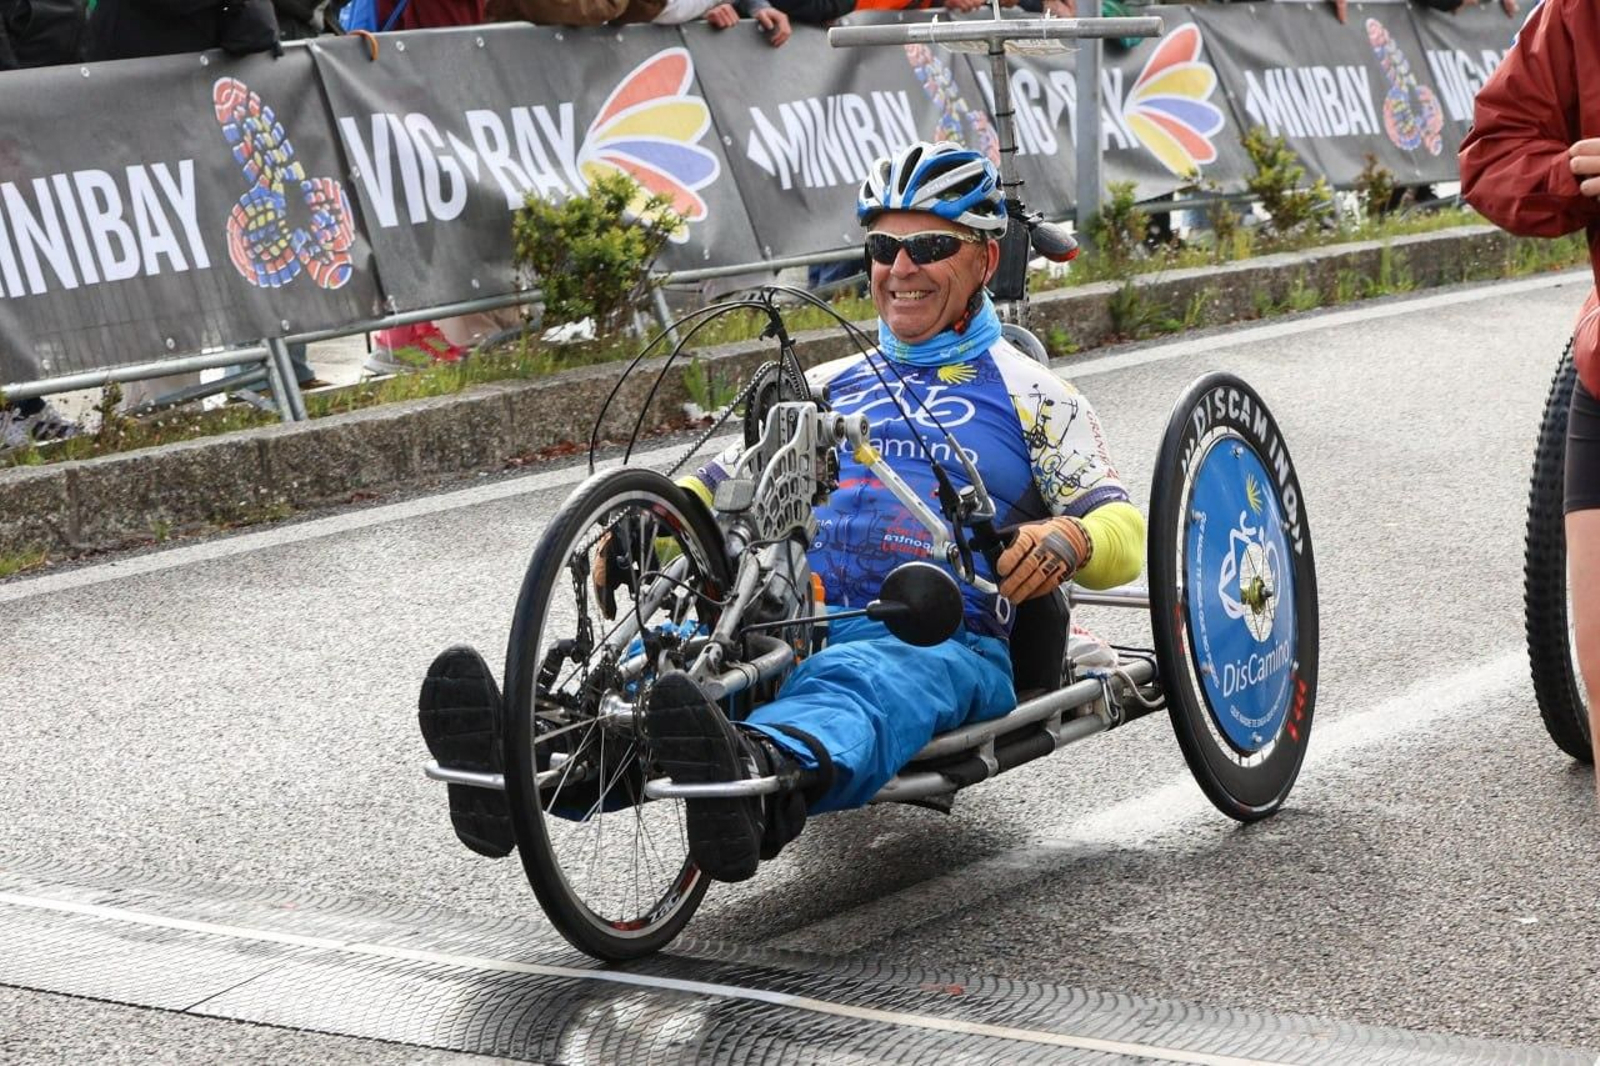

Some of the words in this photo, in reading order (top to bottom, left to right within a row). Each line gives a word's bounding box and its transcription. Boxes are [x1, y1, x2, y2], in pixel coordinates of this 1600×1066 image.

[749, 90, 922, 190] MINIBAY
[1245, 66, 1380, 138] MINIBAY
[0, 159, 211, 298] INIBAY
[1223, 639, 1290, 697] DisCamino
